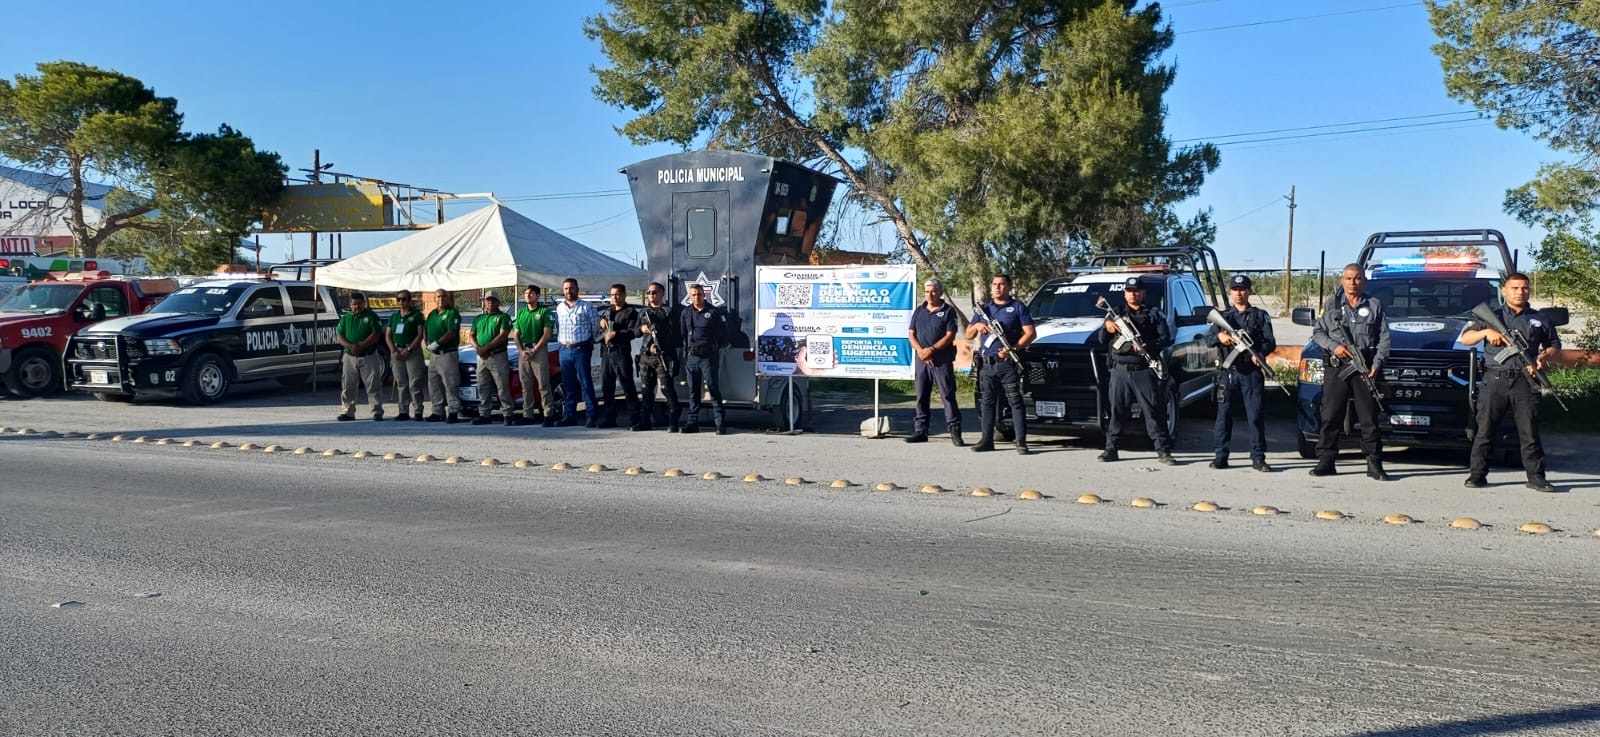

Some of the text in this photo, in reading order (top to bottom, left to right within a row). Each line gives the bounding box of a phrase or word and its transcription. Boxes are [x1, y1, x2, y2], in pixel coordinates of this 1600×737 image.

[658, 167, 744, 184] POLICIA MUNICIPAL
[819, 296, 891, 304] SUGERENCIA
[21, 326, 53, 339] 9402
[246, 331, 280, 351] POLICIA
[165, 370, 176, 382] 02
[1395, 389, 1422, 398] SSP
